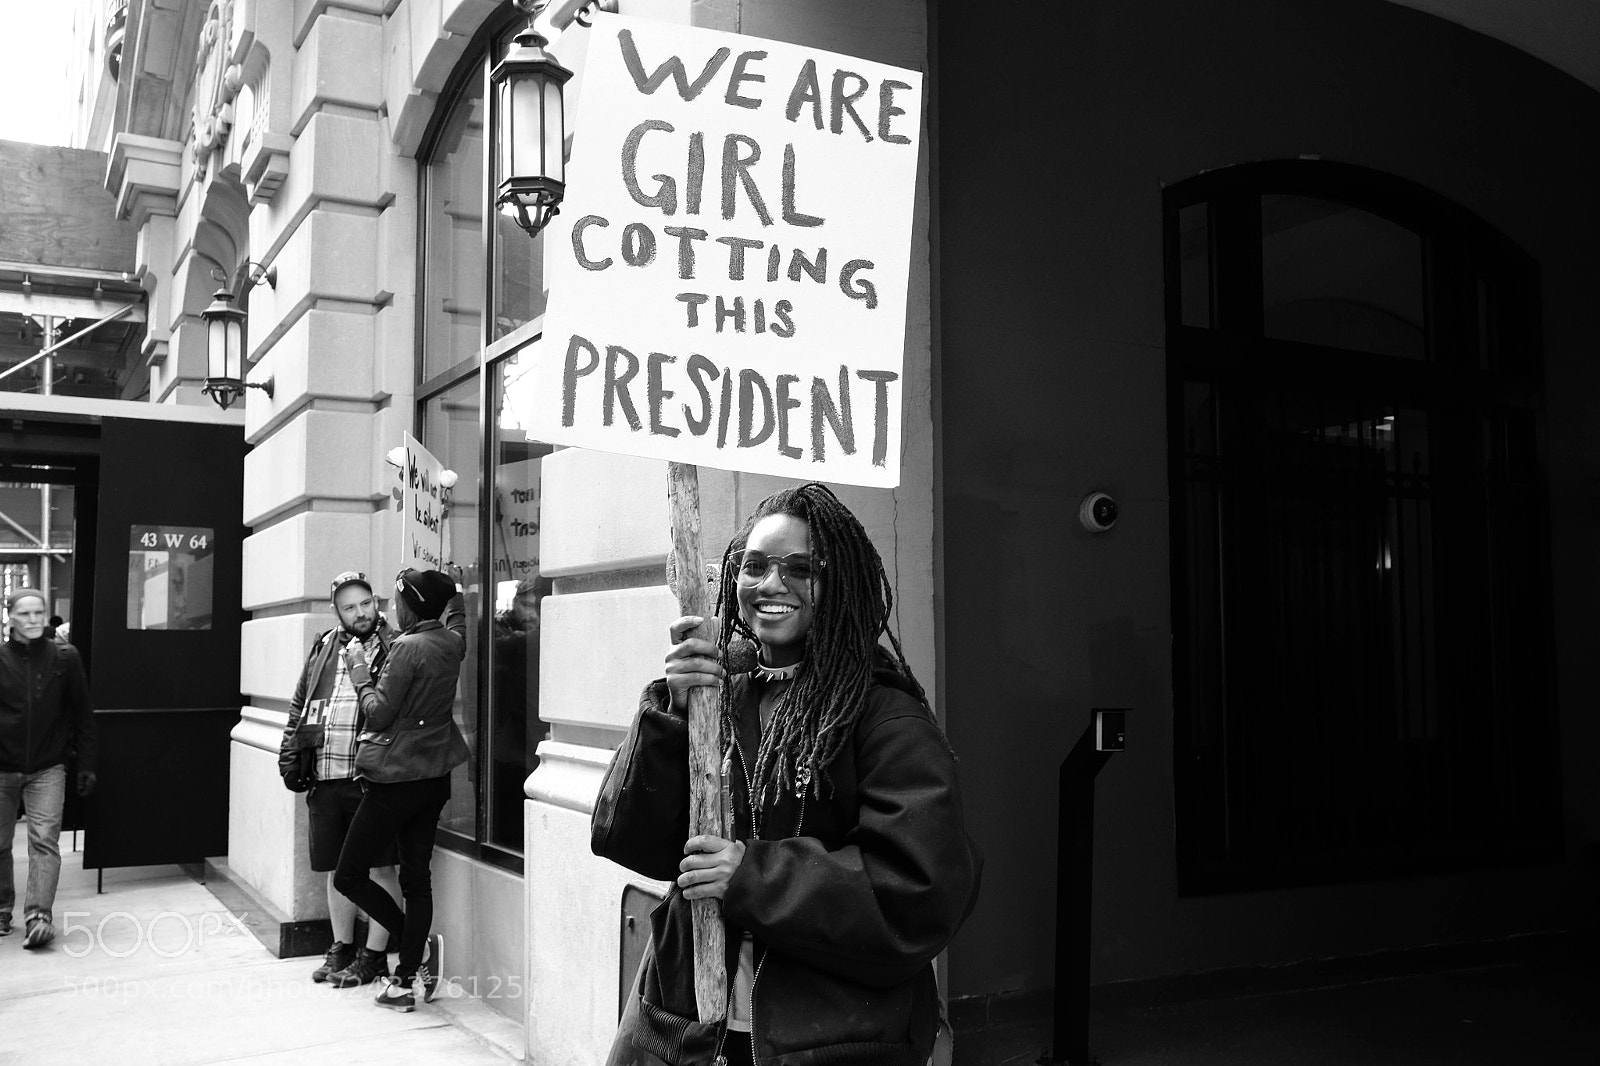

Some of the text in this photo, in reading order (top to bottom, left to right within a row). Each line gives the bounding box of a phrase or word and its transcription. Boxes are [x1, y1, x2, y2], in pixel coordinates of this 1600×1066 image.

[617, 28, 913, 145] WE ARE
[621, 119, 826, 228] GIRL
[571, 214, 879, 310] COTTING
[675, 292, 797, 338] THIS
[561, 334, 899, 468] PRESIDENT
[406, 447, 420, 490] We
[140, 532, 208, 550] 43 W 64
